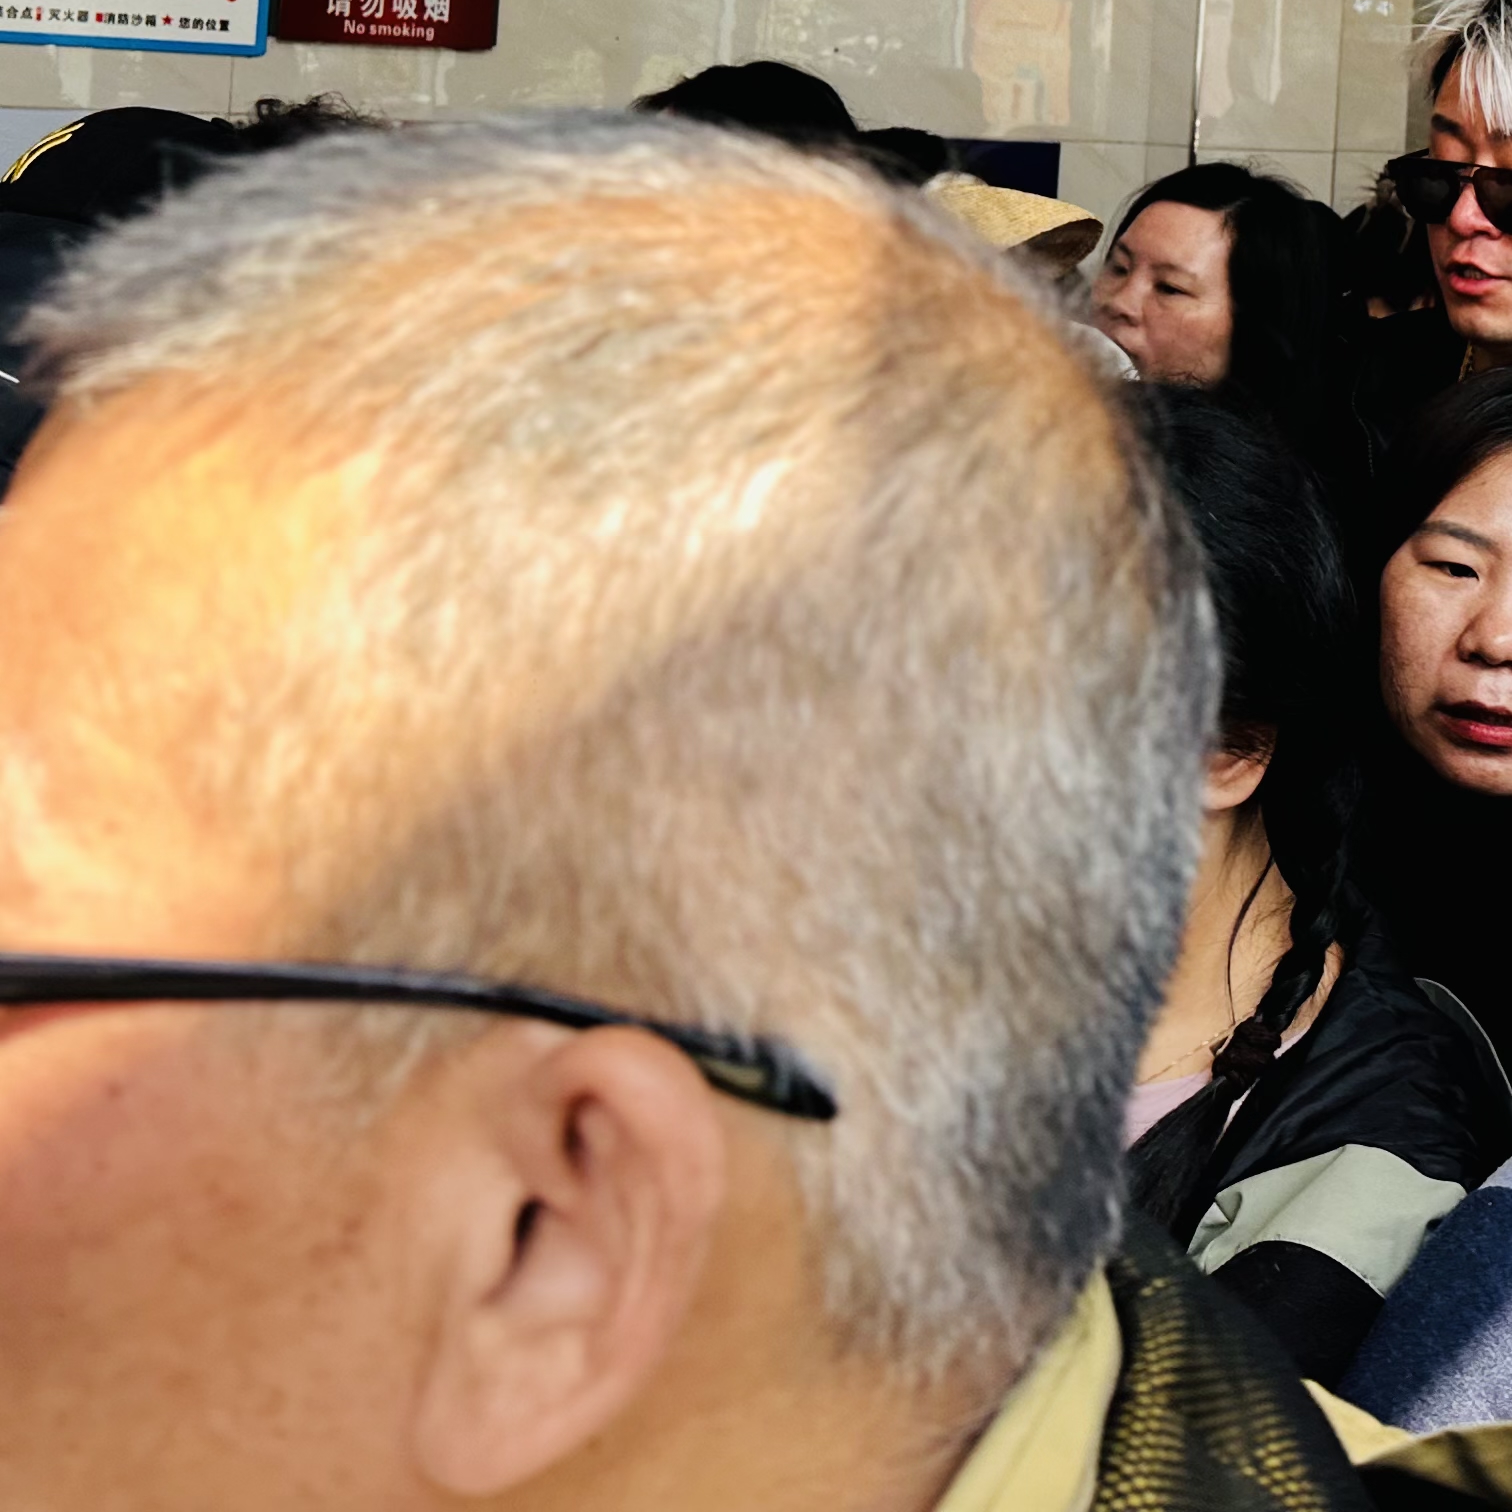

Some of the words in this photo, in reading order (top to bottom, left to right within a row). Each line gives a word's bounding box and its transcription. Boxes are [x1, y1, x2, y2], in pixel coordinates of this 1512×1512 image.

[0, 5, 33, 20] 合点
[48, 7, 89, 23] 灭火器
[178, 16, 230, 31] 您的位置
[344, 19, 366, 35] No
[369, 22, 435, 42] smoking
